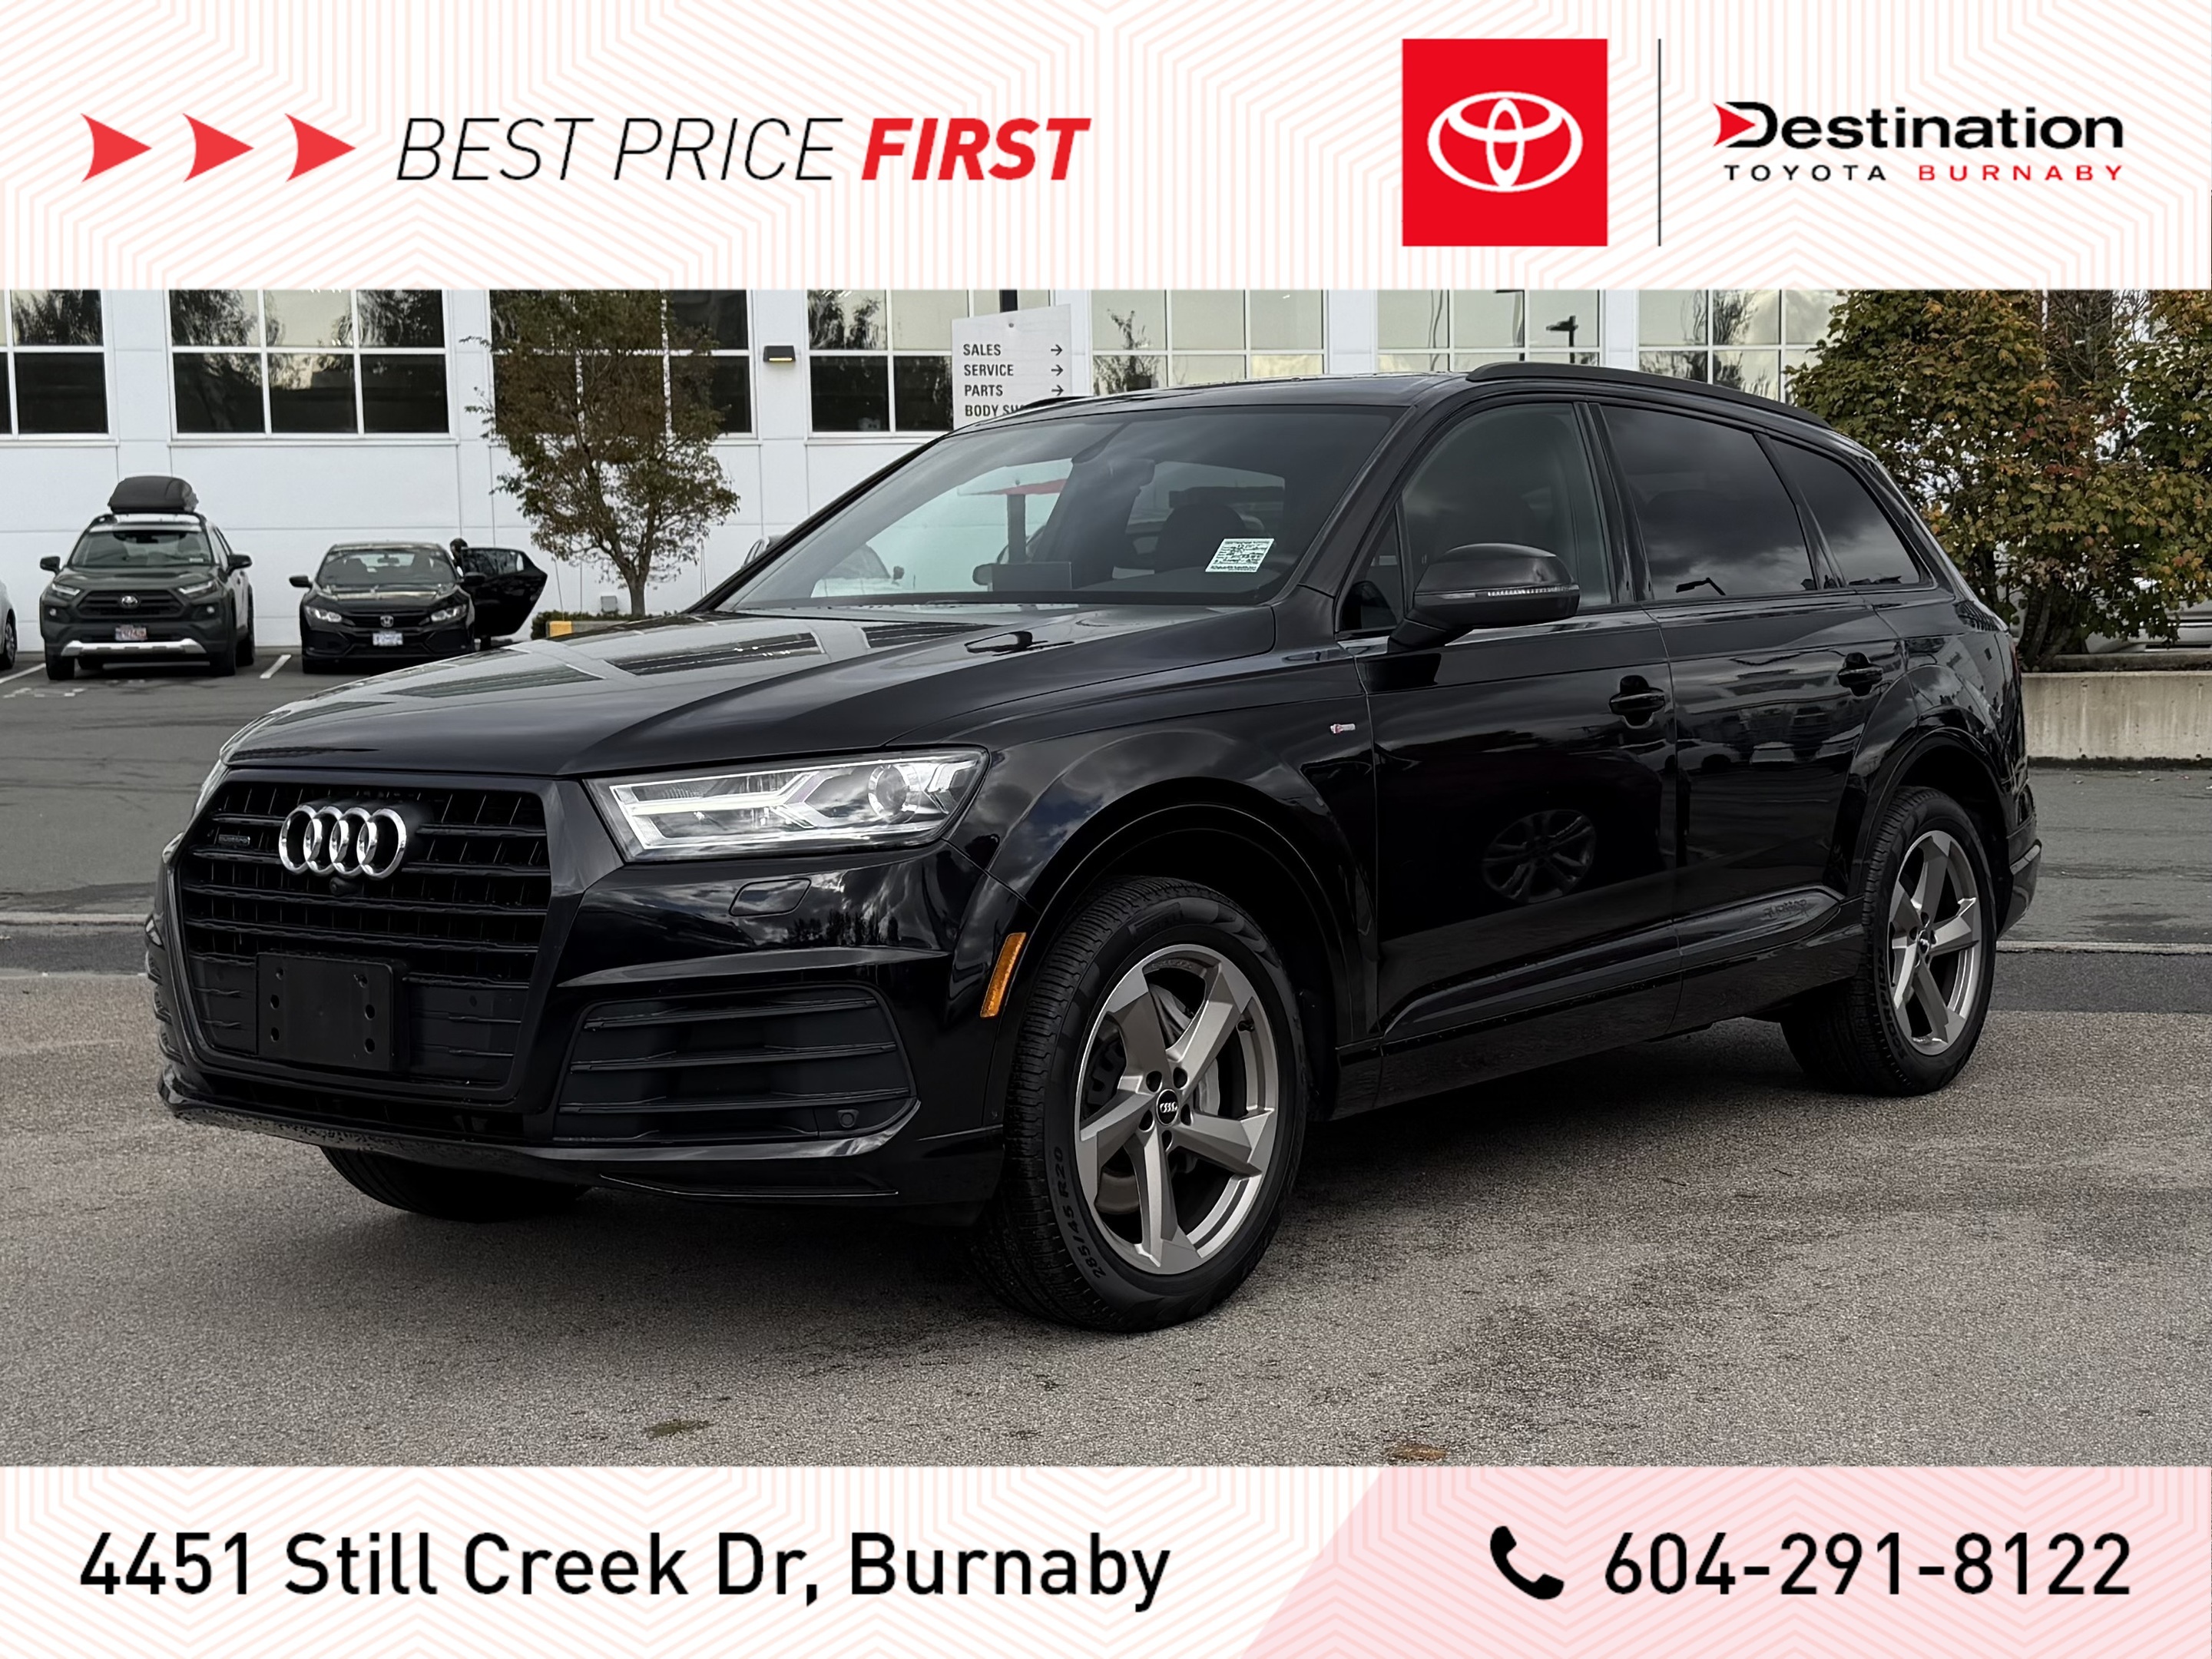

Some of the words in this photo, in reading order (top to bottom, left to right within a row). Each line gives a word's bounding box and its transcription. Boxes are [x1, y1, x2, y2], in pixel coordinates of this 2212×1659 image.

[963, 343, 1002, 356] SALES
[964, 364, 1014, 376] SERVICE
[965, 385, 1003, 396] PARTS
[965, 405, 998, 417] BODY
[1054, 1146, 1070, 1198] R20
